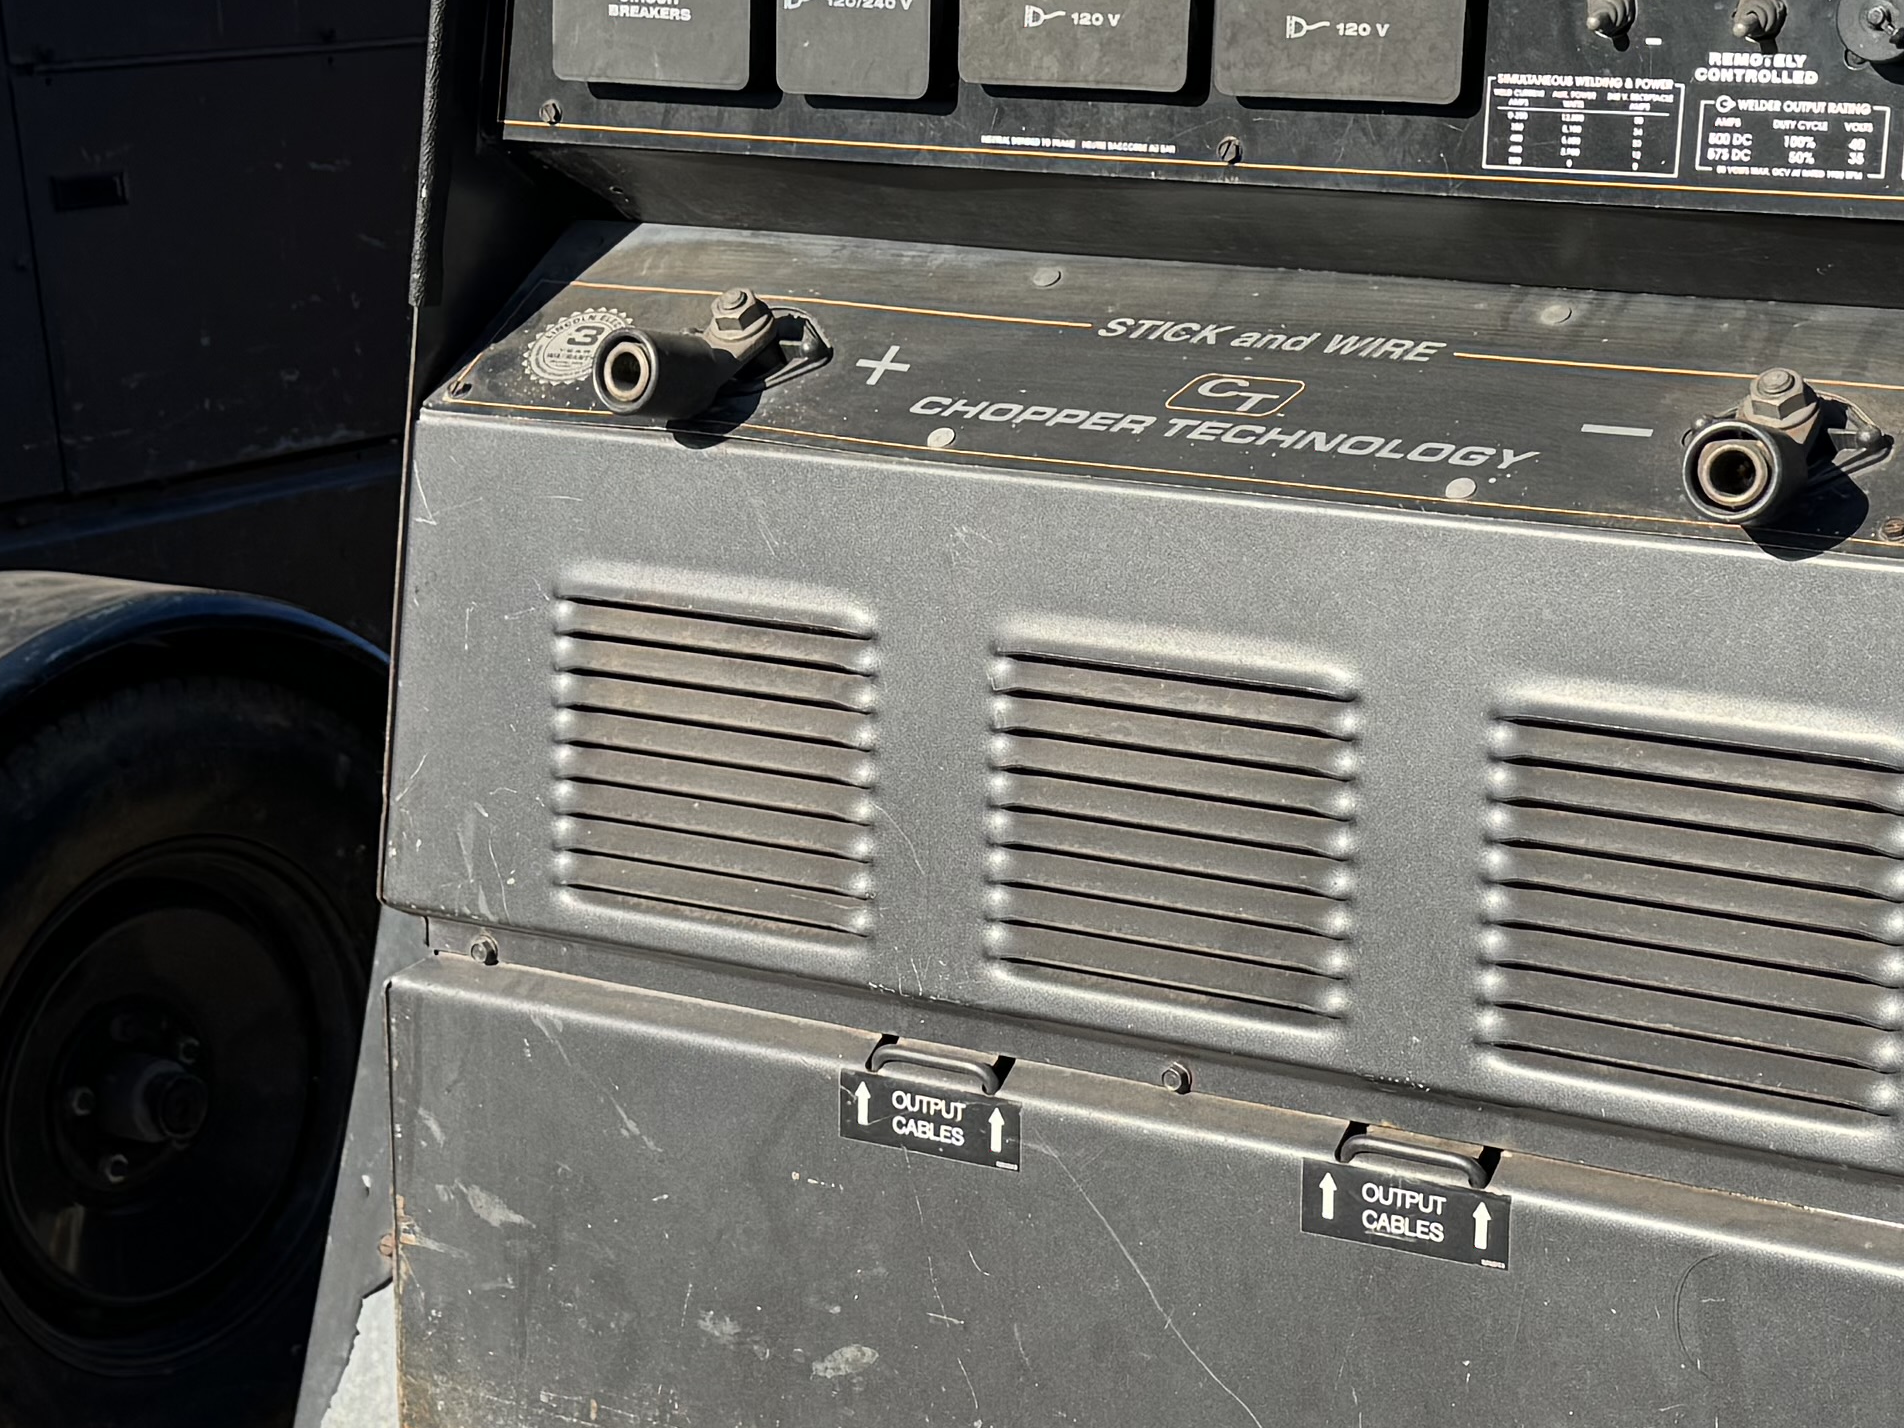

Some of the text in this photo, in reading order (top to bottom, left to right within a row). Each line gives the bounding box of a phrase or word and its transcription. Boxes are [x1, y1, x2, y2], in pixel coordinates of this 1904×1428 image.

[607, 3, 692, 22] BREAKERS
[1070, 10, 1122, 28] 120 V
[1335, 22, 1390, 38] 120 V
[1708, 51, 1807, 70] REMOTELY
[1497, 74, 1674, 90] SIMULTANEOUS WELDING POWER
[1694, 67, 1819, 86] CONTROLLED
[1737, 99, 1872, 115] WELDER OUTPUT RATING
[1732, 132, 1753, 146] DC
[1731, 148, 1752, 162] DC
[567, 325, 605, 346] 3
[1097, 317, 1447, 364] STICK and WIRE
[1197, 378, 1280, 413] CT
[908, 395, 1538, 471] CHOPPER TECHNOLOGY
[891, 1089, 967, 1121] OUTPUT
[891, 1115, 965, 1148] CABLES
[1360, 1181, 1447, 1217] OUTPUT
[1360, 1208, 1445, 1244] CABLES
